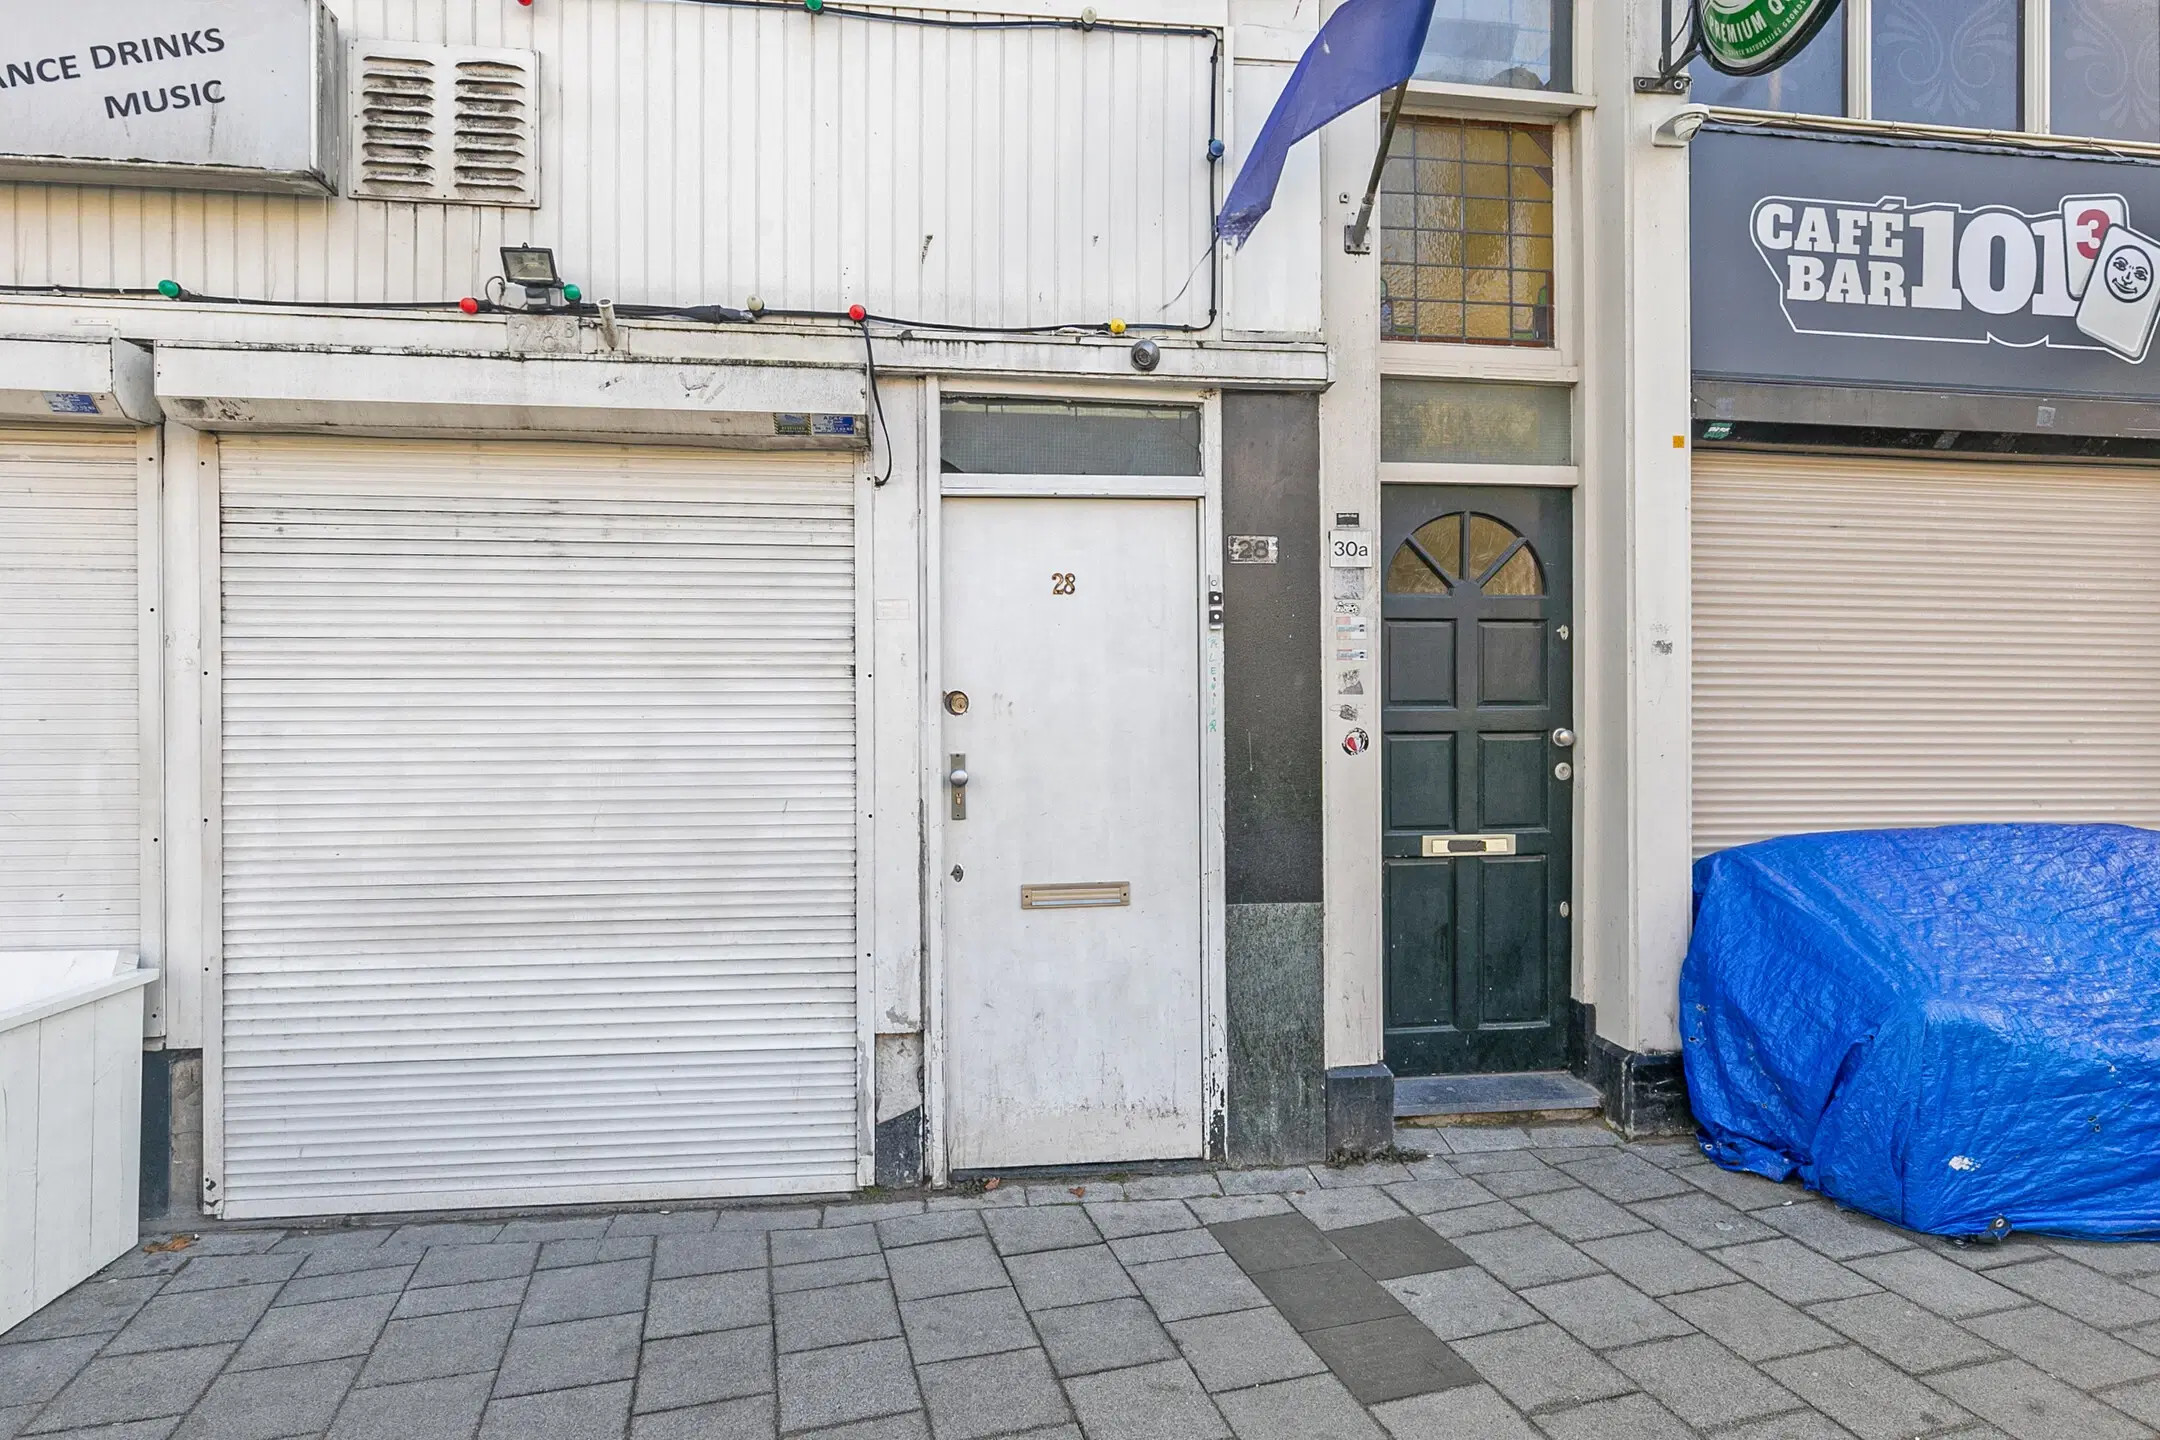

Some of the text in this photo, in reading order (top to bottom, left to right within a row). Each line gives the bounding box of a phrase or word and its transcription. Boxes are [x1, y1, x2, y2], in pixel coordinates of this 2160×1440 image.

[1709, 10, 1767, 43] PREMIUM
[90, 28, 225, 69] DRINKS
[104, 80, 225, 119] MUSIC
[1757, 203, 1904, 257] CAFÉ
[2076, 209, 2111, 260] 3
[1787, 255, 1907, 307] BAR
[1238, 540, 1269, 558] 28
[1334, 541, 1368, 557] 30a
[1051, 572, 1076, 595] 28
